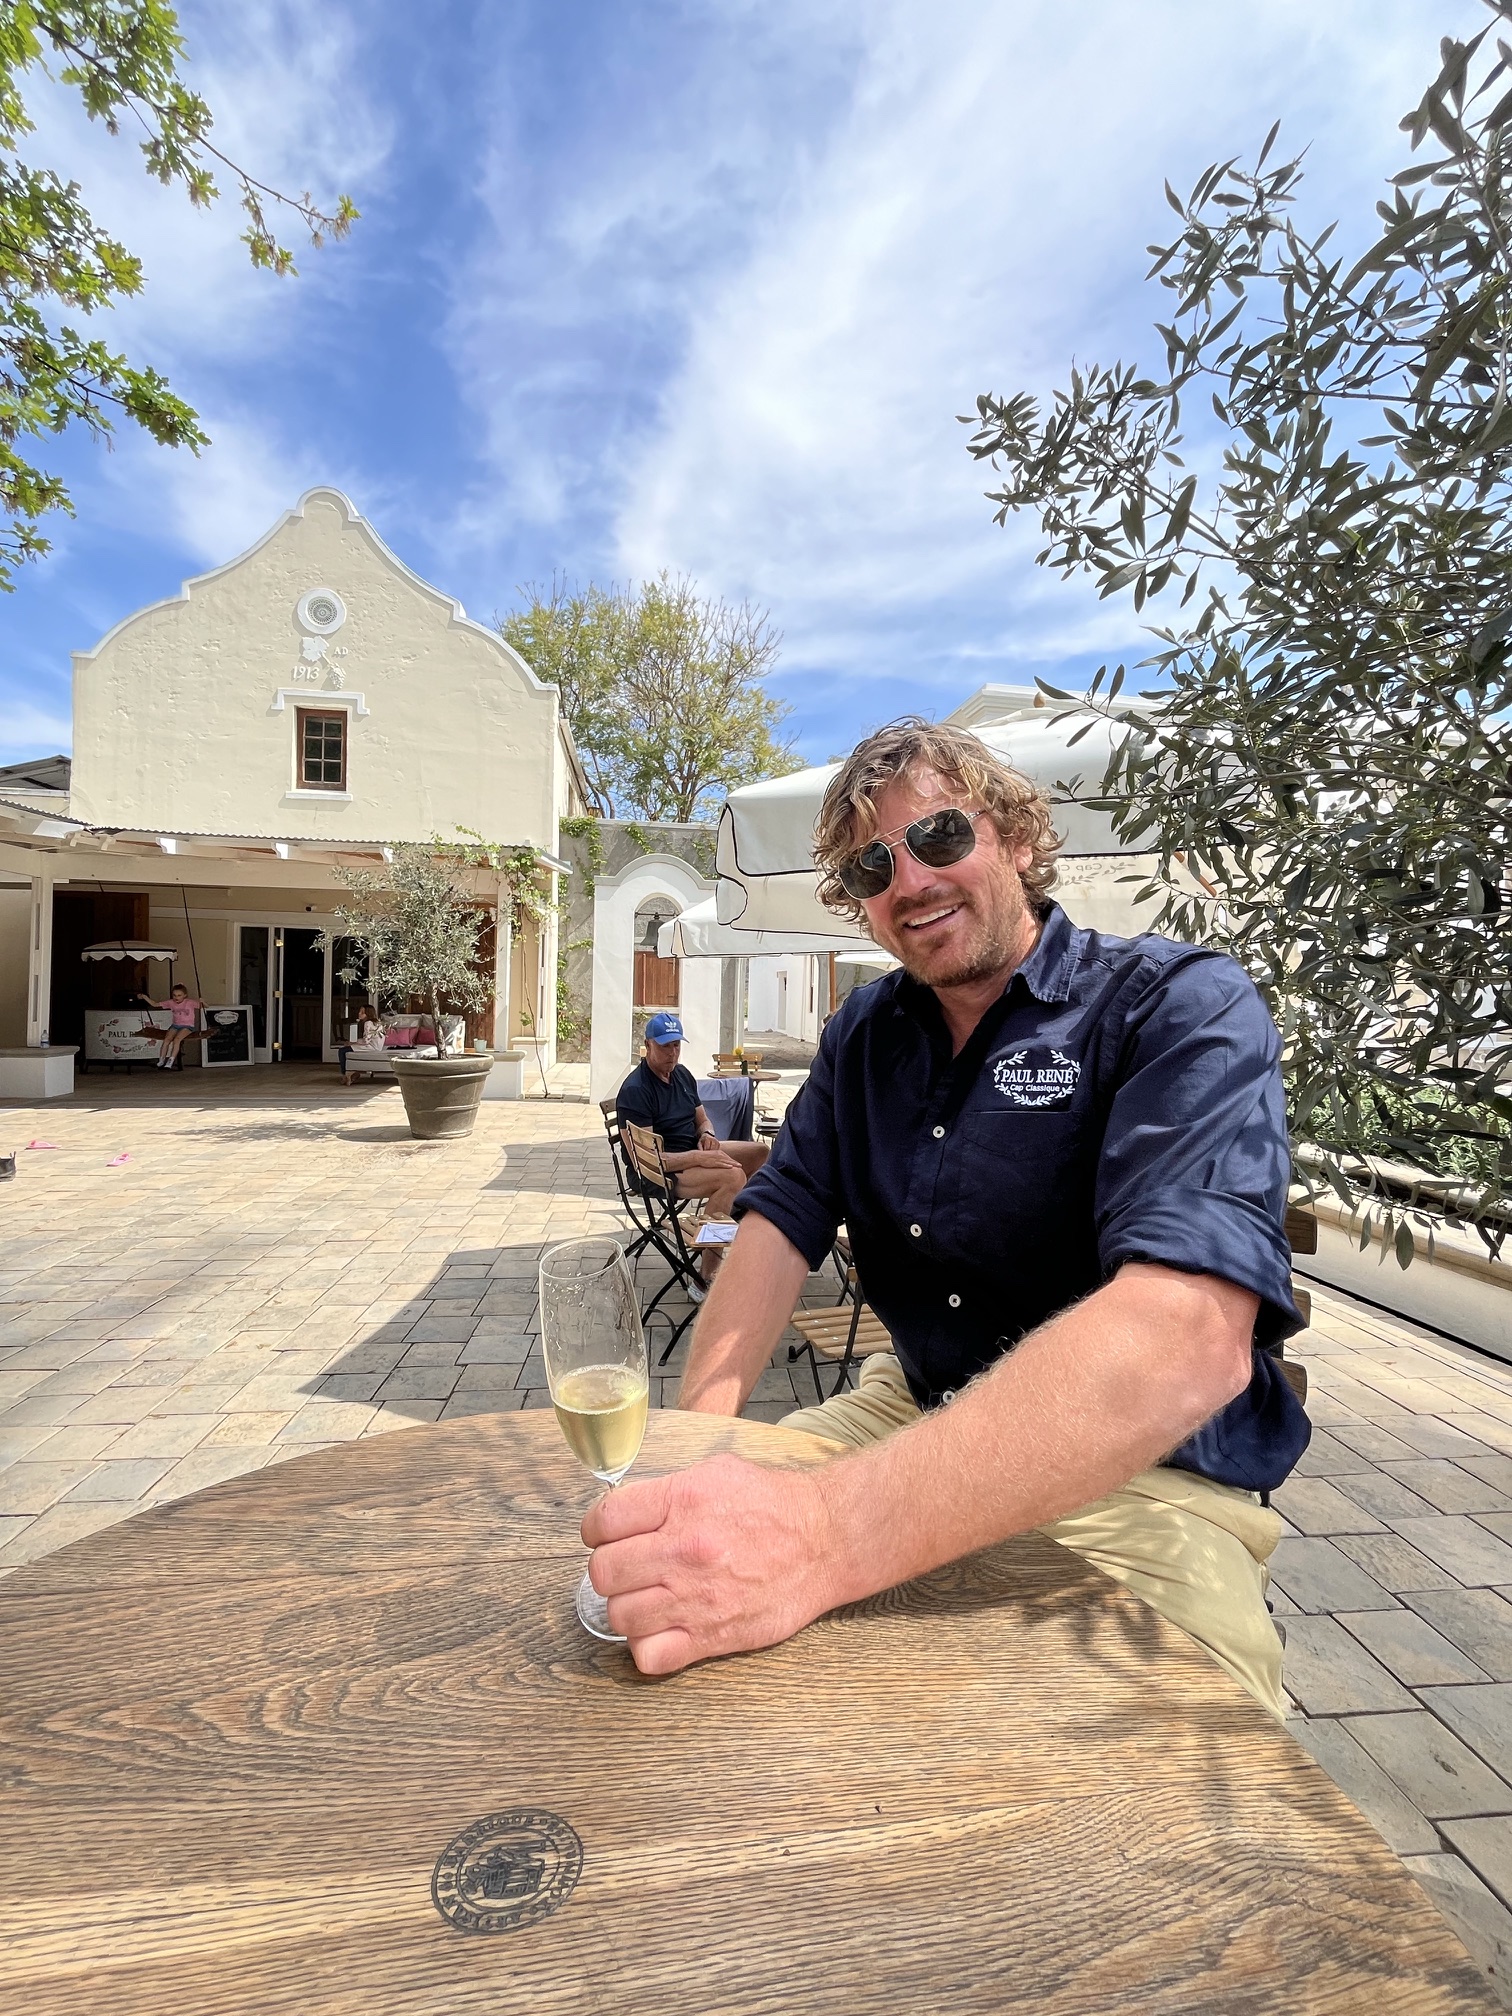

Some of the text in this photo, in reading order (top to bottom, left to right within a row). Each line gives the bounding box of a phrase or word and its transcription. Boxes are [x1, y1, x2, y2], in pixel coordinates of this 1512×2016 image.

[293, 665, 320, 680] 1913
[1000, 1066, 1074, 1084] PAUL RENÉ
[1009, 1084, 1060, 1093] Cap Classique
